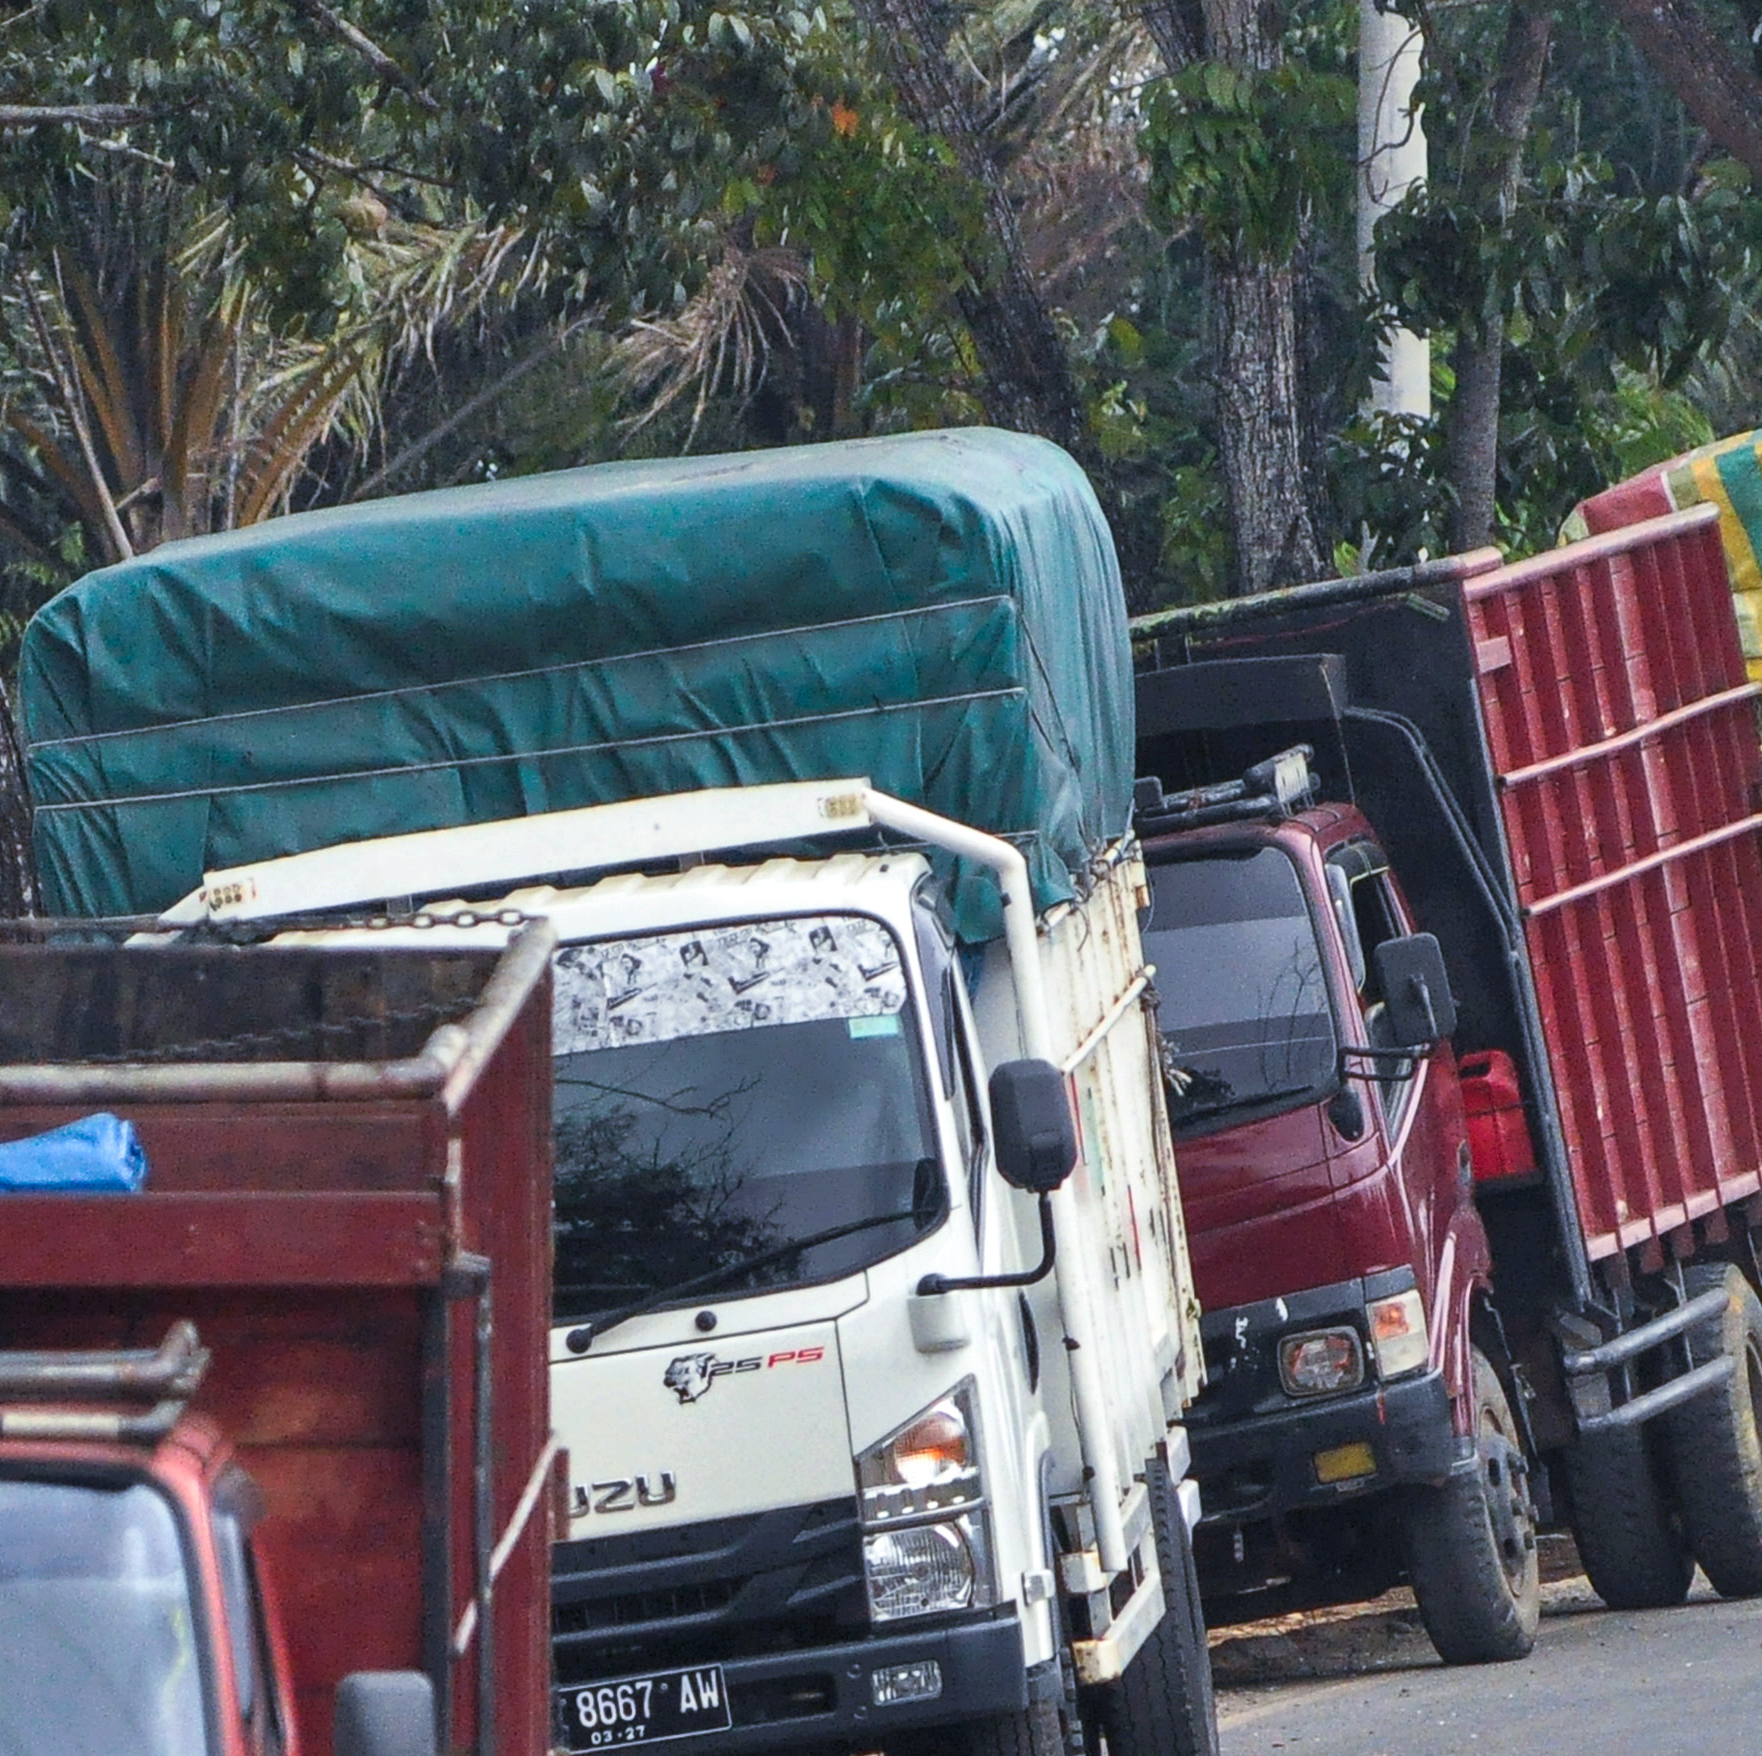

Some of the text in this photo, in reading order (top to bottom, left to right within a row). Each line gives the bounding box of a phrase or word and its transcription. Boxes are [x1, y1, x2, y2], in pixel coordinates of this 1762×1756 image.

[767, 1346, 825, 1369] PS
[575, 1680, 653, 1728] 8667
[679, 1668, 720, 1714] AW
